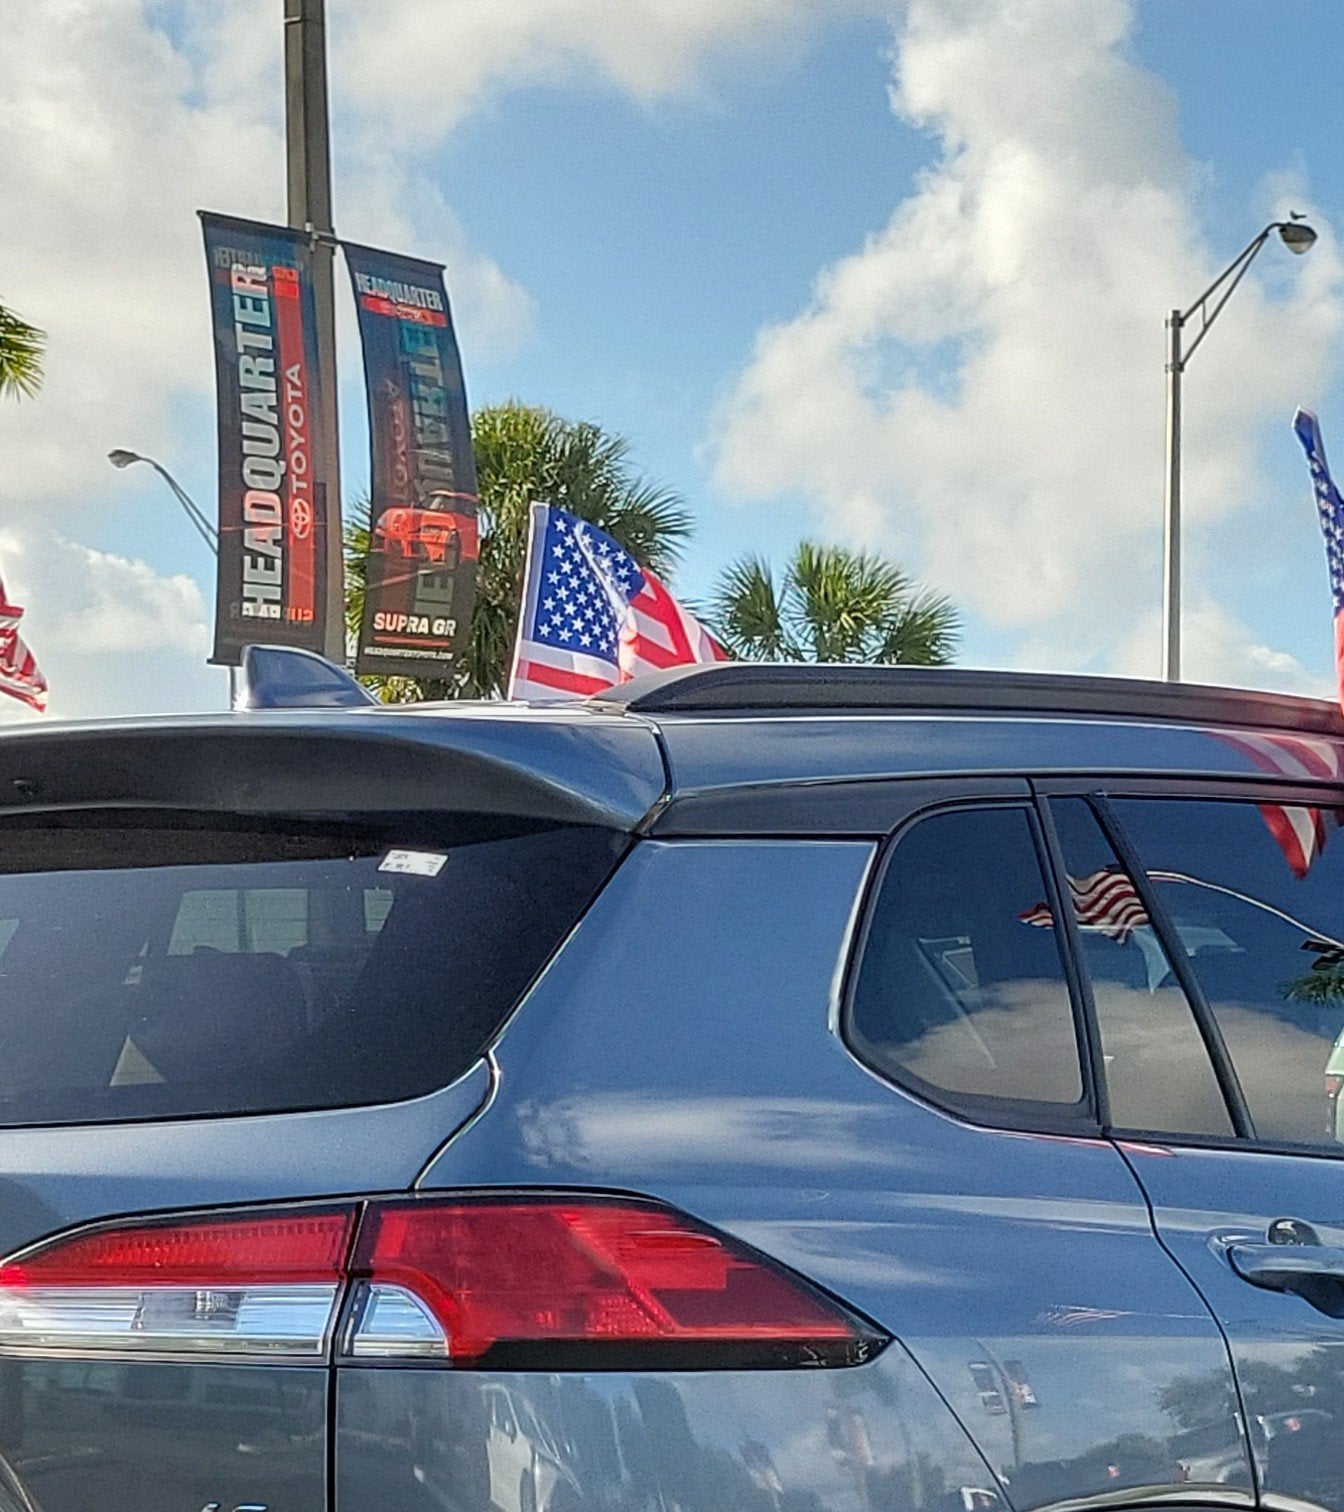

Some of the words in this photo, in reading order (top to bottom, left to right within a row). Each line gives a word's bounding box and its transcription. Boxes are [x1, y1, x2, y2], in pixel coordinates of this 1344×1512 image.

[231, 264, 286, 619] HEADQUARTER
[285, 363, 310, 496] TOYOTA
[373, 612, 429, 635] SUPRA
[431, 618, 456, 637] GR
